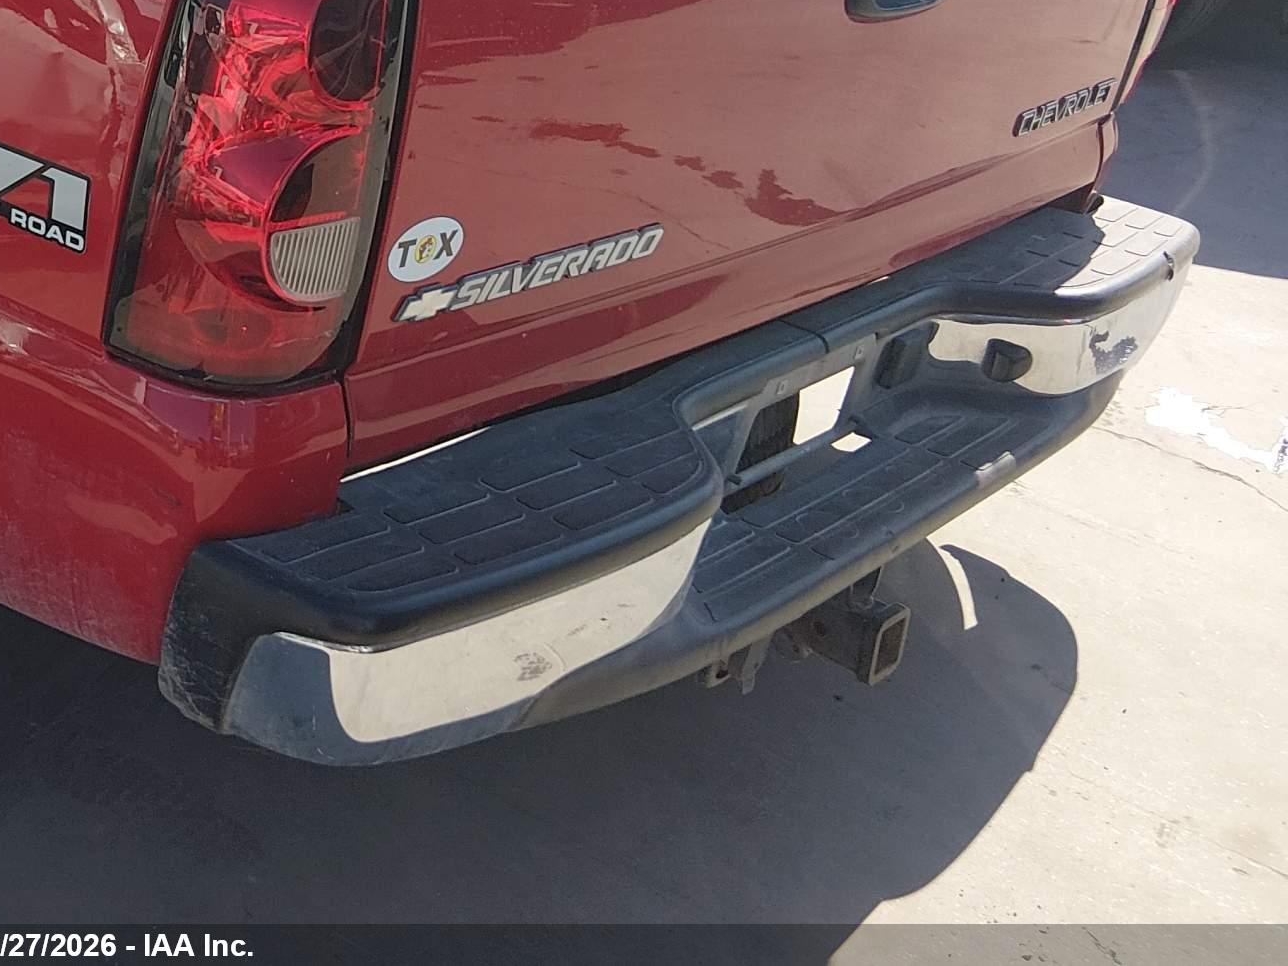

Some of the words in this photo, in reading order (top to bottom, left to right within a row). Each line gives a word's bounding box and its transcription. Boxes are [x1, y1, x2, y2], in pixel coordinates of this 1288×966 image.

[1013, 77, 1118, 137] CHEVROLET
[9, 208, 85, 253] ROAD
[450, 225, 664, 311] SILVERADO
